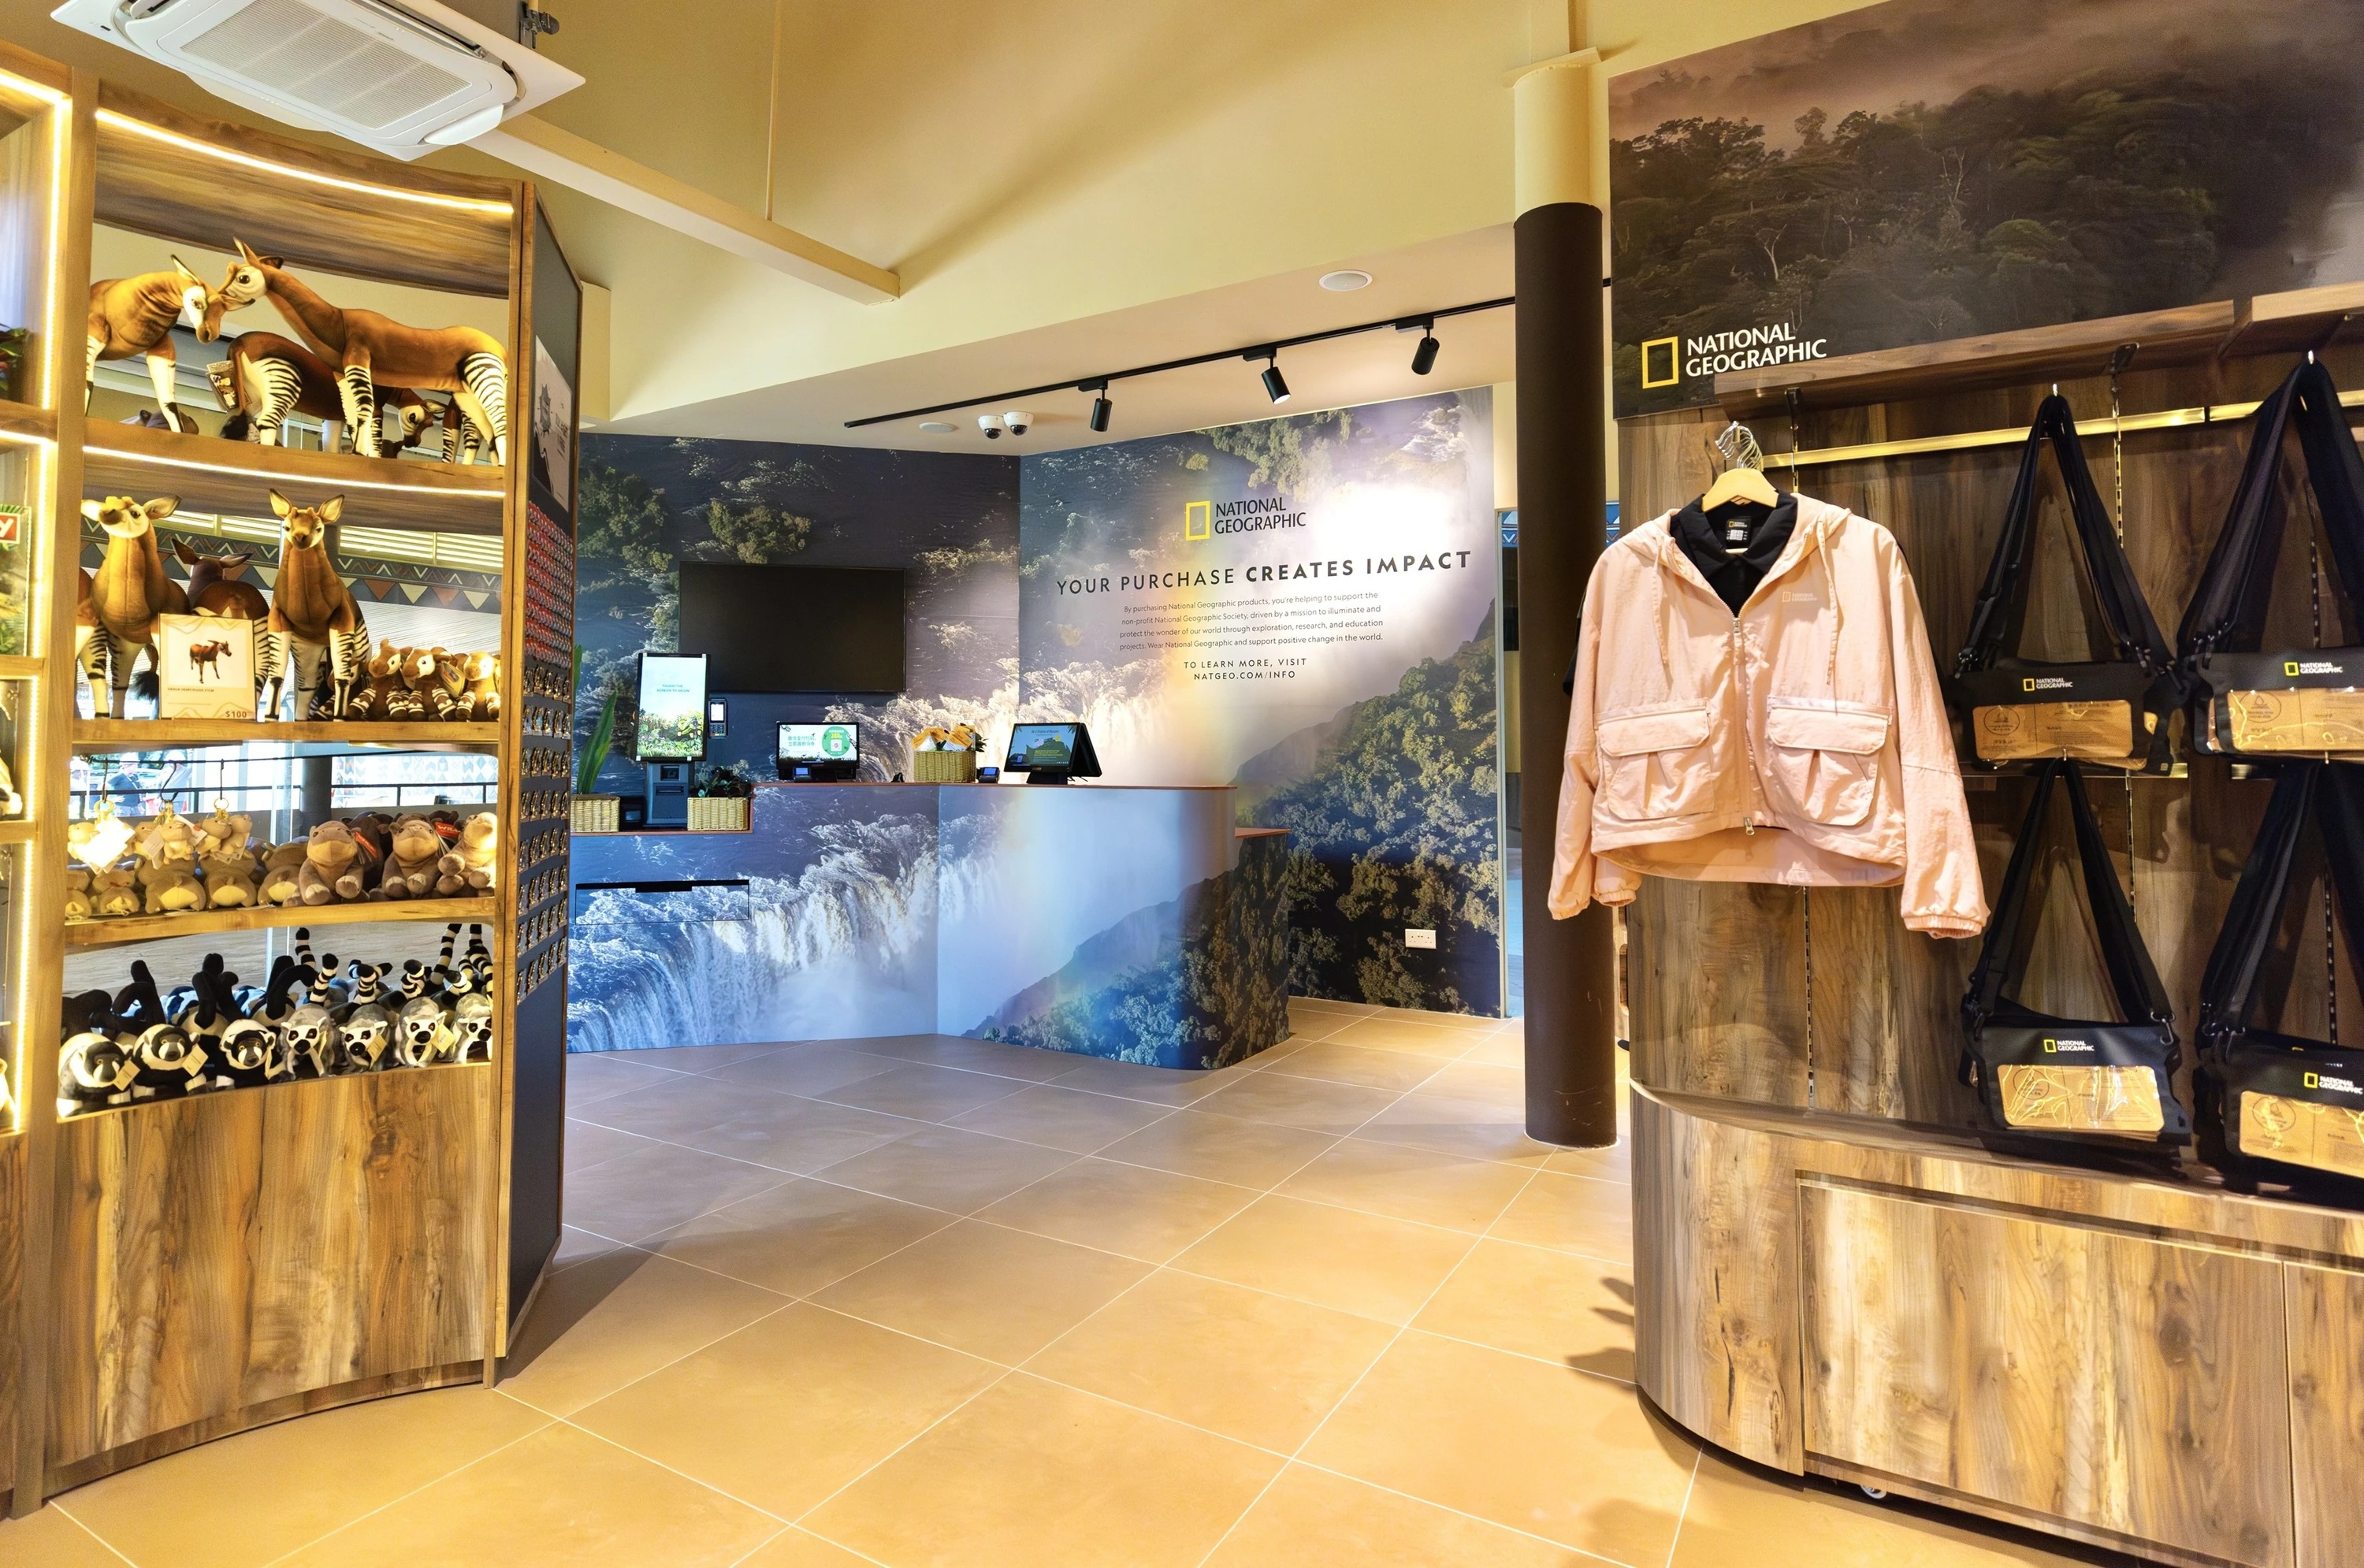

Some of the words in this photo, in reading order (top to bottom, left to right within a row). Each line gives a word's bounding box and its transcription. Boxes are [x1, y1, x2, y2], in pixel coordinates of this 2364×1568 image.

[1687, 322, 1796, 356] NATIONAL
[1686, 338, 1827, 377] GEOGRAPHIC
[1216, 496, 1287, 518] NATIONAL
[1214, 512, 1307, 534] GEOGRAPHIC
[1057, 578, 1110, 595] YOUR
[1121, 568, 1234, 591] PURCHASE
[1246, 559, 1354, 582] CREATES
[1366, 550, 1471, 574] IMPACT
[1133, 605, 1167, 614] purchasing
[1197, 600, 1236, 609] Geographic
[1237, 598, 1270, 607] products,
[1271, 596, 1293, 605] you're
[1295, 595, 1322, 604] helping
[1334, 593, 1363, 602] support
[1121, 617, 1154, 626] non-profit
[1183, 613, 1221, 622] Geographic
[1222, 612, 1249, 621] Society,
[1274, 610, 1283, 619] by
[1120, 630, 1143, 639] protect
[1222, 625, 1251, 634] through
[1251, 623, 1294, 633] exploration,
[1120, 643, 1147, 652] projects.
[1194, 639, 1232, 648] Geographic
[1277, 637, 1307, 645] positive
[1308, 636, 1335, 645] change
[1239, 659, 1273, 667] MORE,
[1194, 671, 1295, 680] NATGEO.COM/INFO
[2035, 681, 2073, 689] GEOGRAPHIC
[2318, 1081, 2363, 1094] GEOGRAPHIC
[2319, 1076, 2355, 1087] NATIONAL
